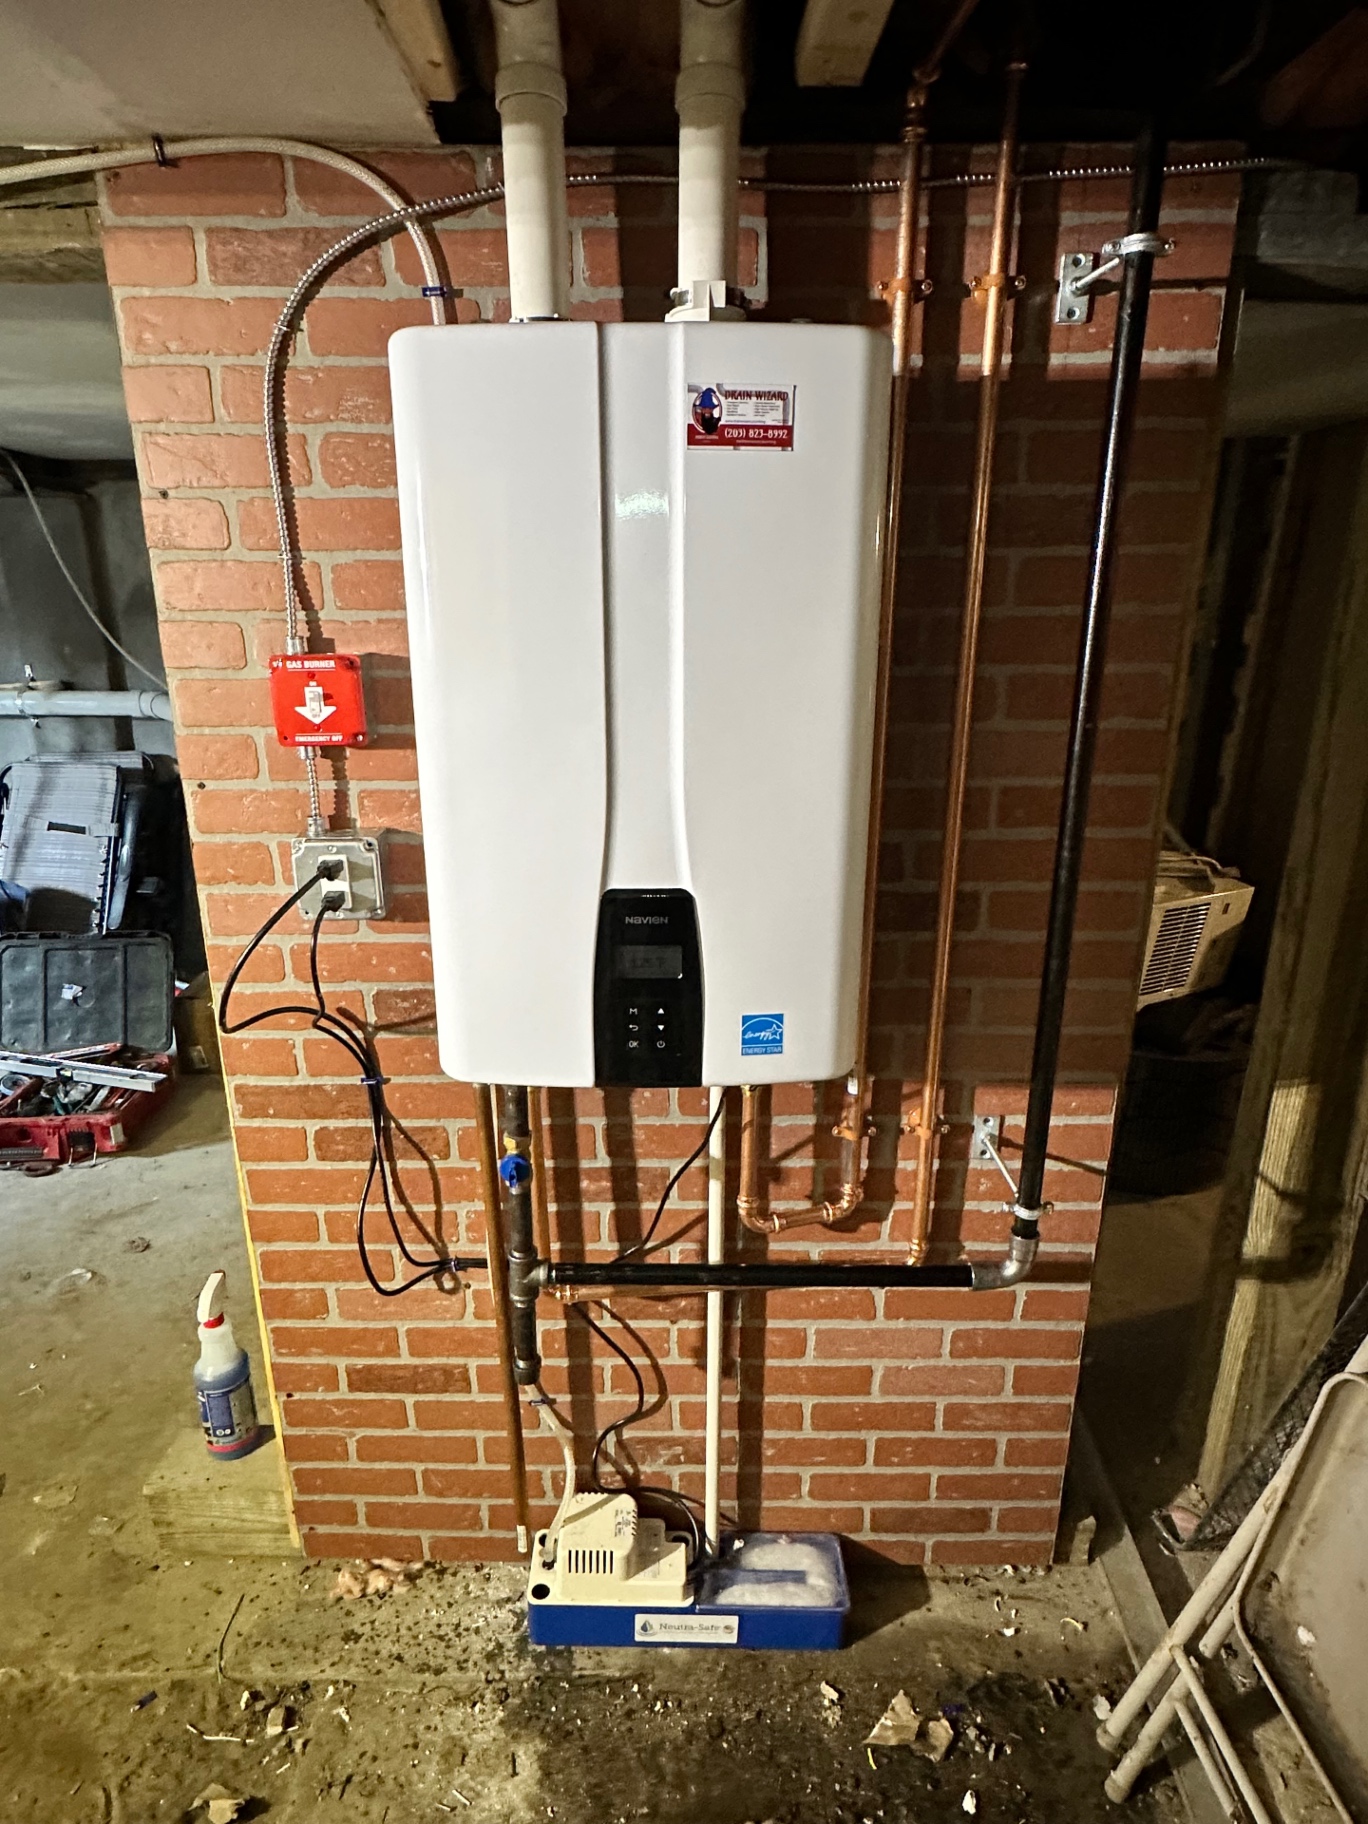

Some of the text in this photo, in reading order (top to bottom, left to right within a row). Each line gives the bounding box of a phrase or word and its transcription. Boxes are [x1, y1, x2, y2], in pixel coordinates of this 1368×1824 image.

[725, 390, 789, 402] DRAIN WIZARD
[725, 428, 746, 438] (203)
[749, 429, 788, 439] 823-8992
[286, 660, 336, 669] GAS BURNER
[331, 734, 343, 742] OFF
[743, 1047, 766, 1055] ENERGY
